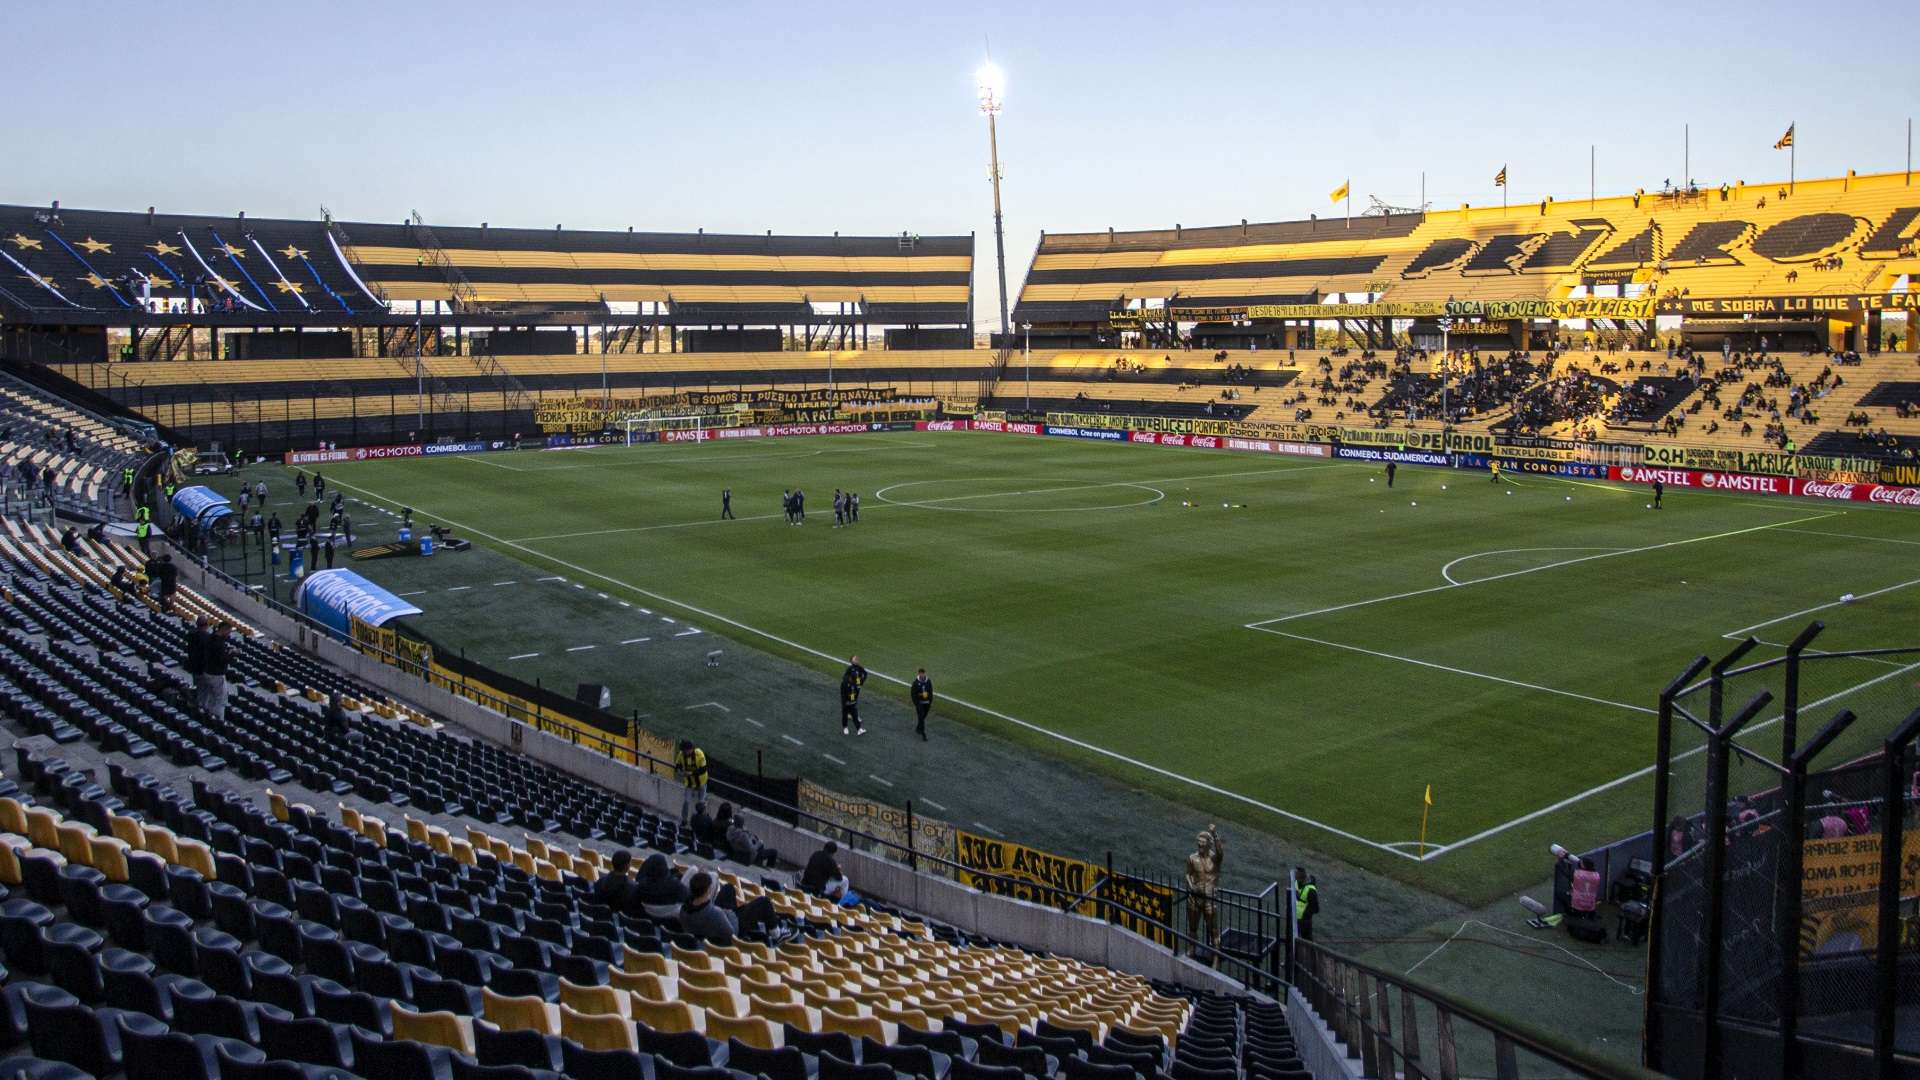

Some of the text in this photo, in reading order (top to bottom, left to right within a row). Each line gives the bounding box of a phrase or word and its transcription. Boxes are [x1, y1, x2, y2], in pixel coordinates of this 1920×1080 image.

[1691, 294, 1920, 312] ME SOBRA LO QUE TE FA
[702, 393, 737, 404] SOMOS
[741, 393, 753, 402] EL
[757, 391, 798, 402] PUEBLO
[387, 446, 422, 456] MOTOR
[1339, 448, 1447, 465] CONMEBOL SUDAMERICANA
[1524, 462, 1596, 476] CONQUISTA
[1635, 468, 1690, 485] AMSTEL
[1717, 475, 1777, 492] AMSTEL
